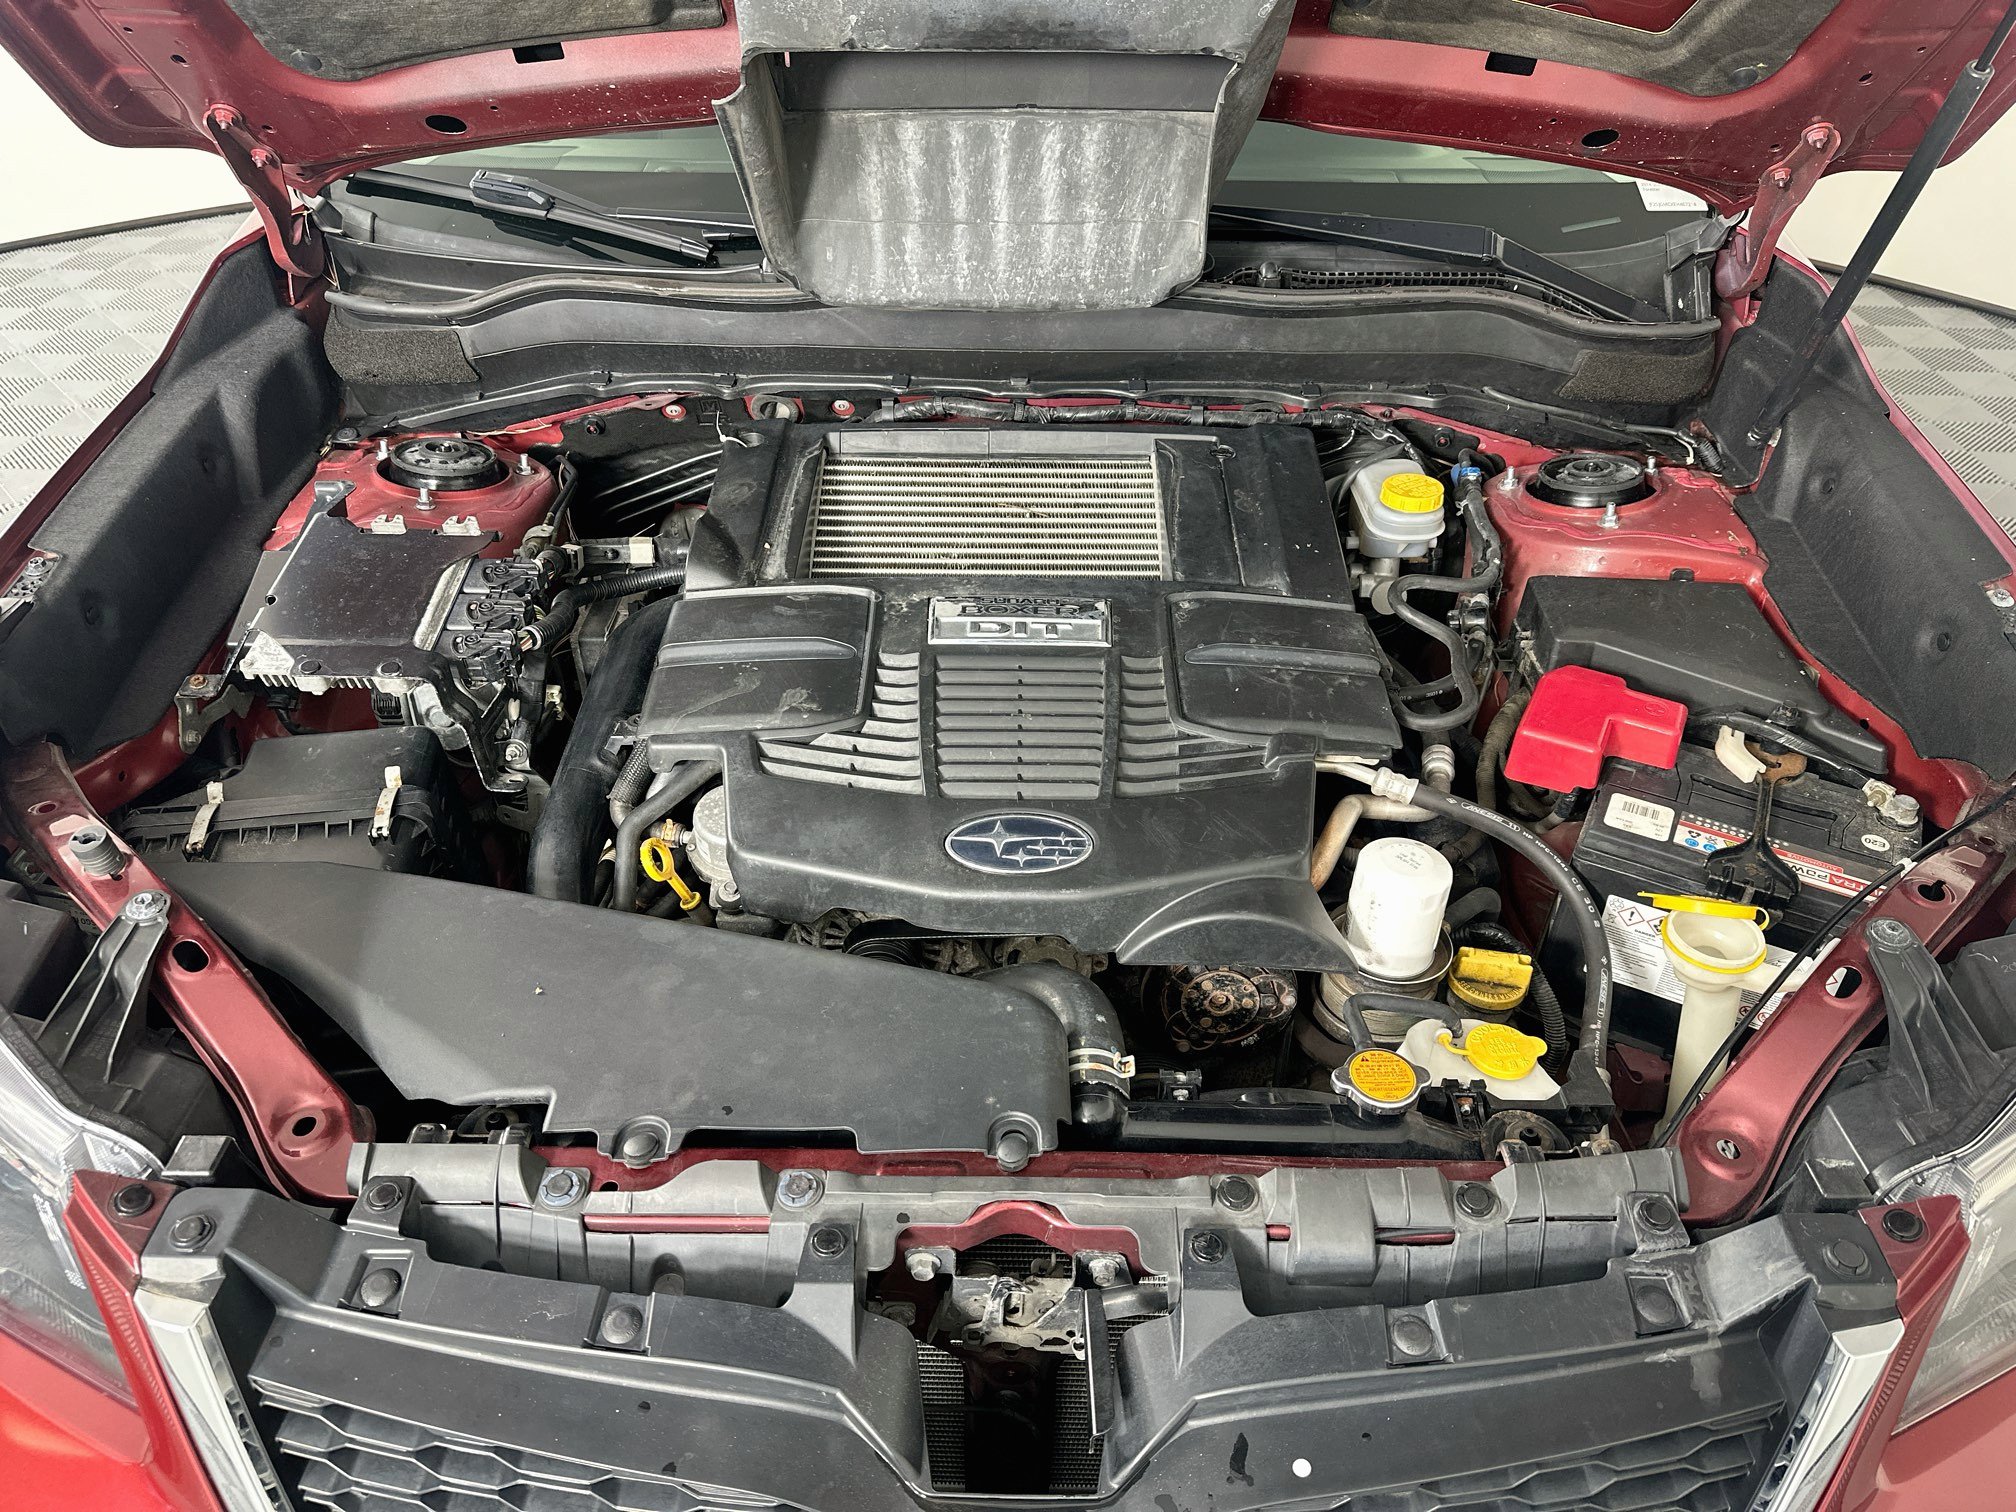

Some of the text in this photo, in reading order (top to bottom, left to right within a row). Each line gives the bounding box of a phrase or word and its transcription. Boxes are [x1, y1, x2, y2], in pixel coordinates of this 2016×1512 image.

[960, 604, 1080, 616] BOXER
[967, 620, 1073, 638] DIT
[1864, 837, 1886, 849] E20
[1787, 853, 1837, 871] AUTOMOTIVE
[1522, 831, 1534, 839] HP
[1535, 840, 1569, 872] HFC-134a
[1571, 877, 1583, 892] CE
[1584, 896, 1595, 913] 30
[1791, 865, 1828, 881] POW
[1459, 980, 1471, 991] SEE
